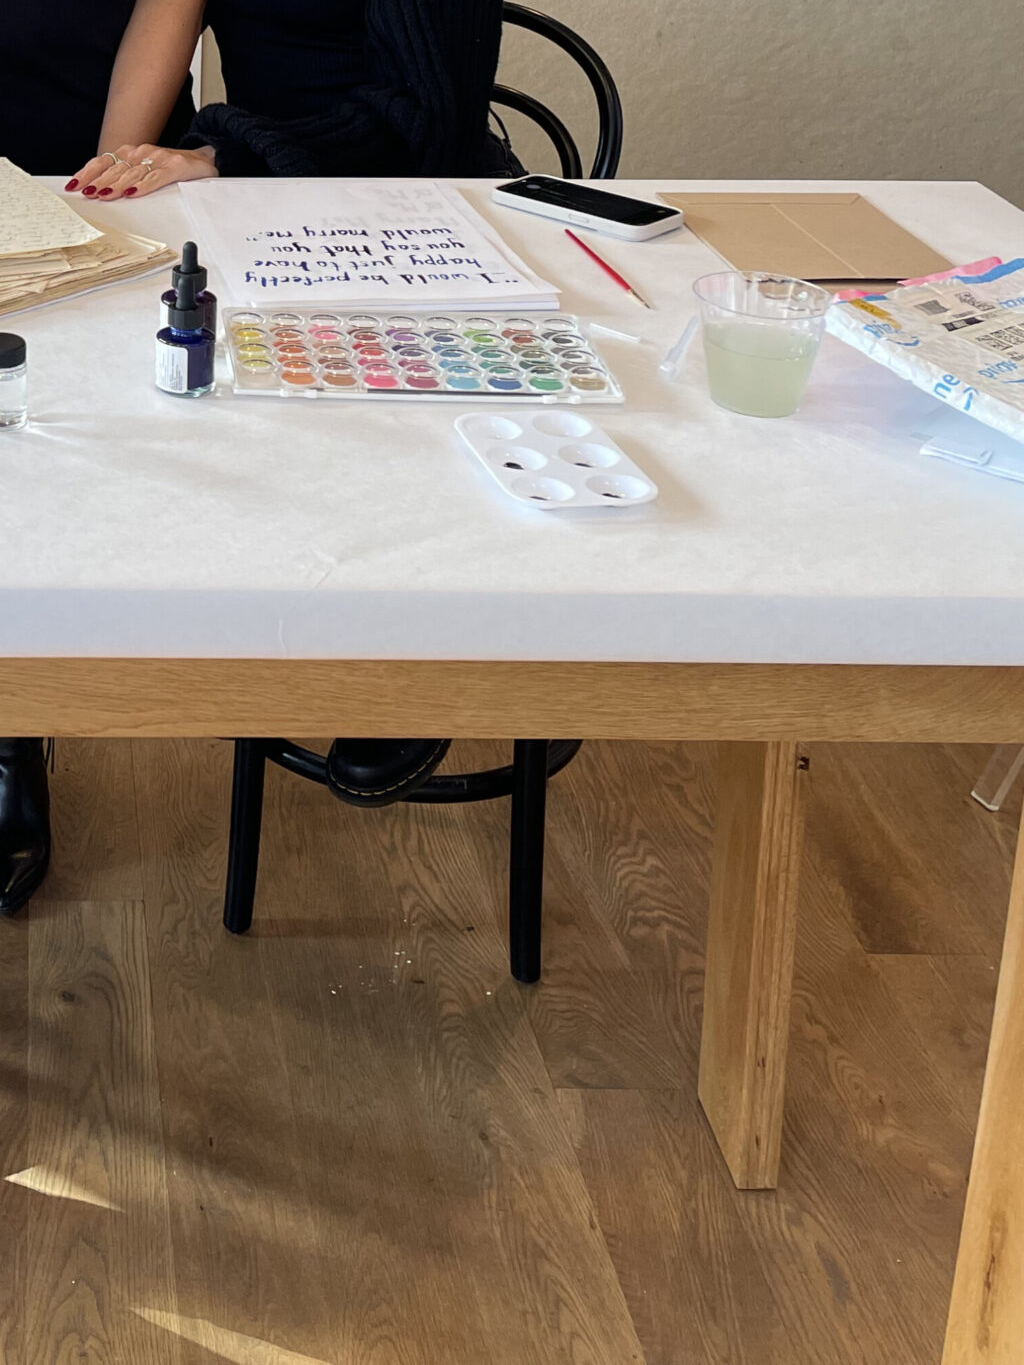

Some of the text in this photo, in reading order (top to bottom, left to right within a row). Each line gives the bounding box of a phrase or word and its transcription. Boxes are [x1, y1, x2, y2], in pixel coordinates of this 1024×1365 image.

[302, 225, 370, 237] marry
[381, 227, 453, 240] would
[271, 237, 466, 257] you say that you
[254, 254, 482, 272] happy just to have
[244, 271, 351, 288] perfectly
[359, 273, 390, 285] be
[401, 272, 470, 285] would
